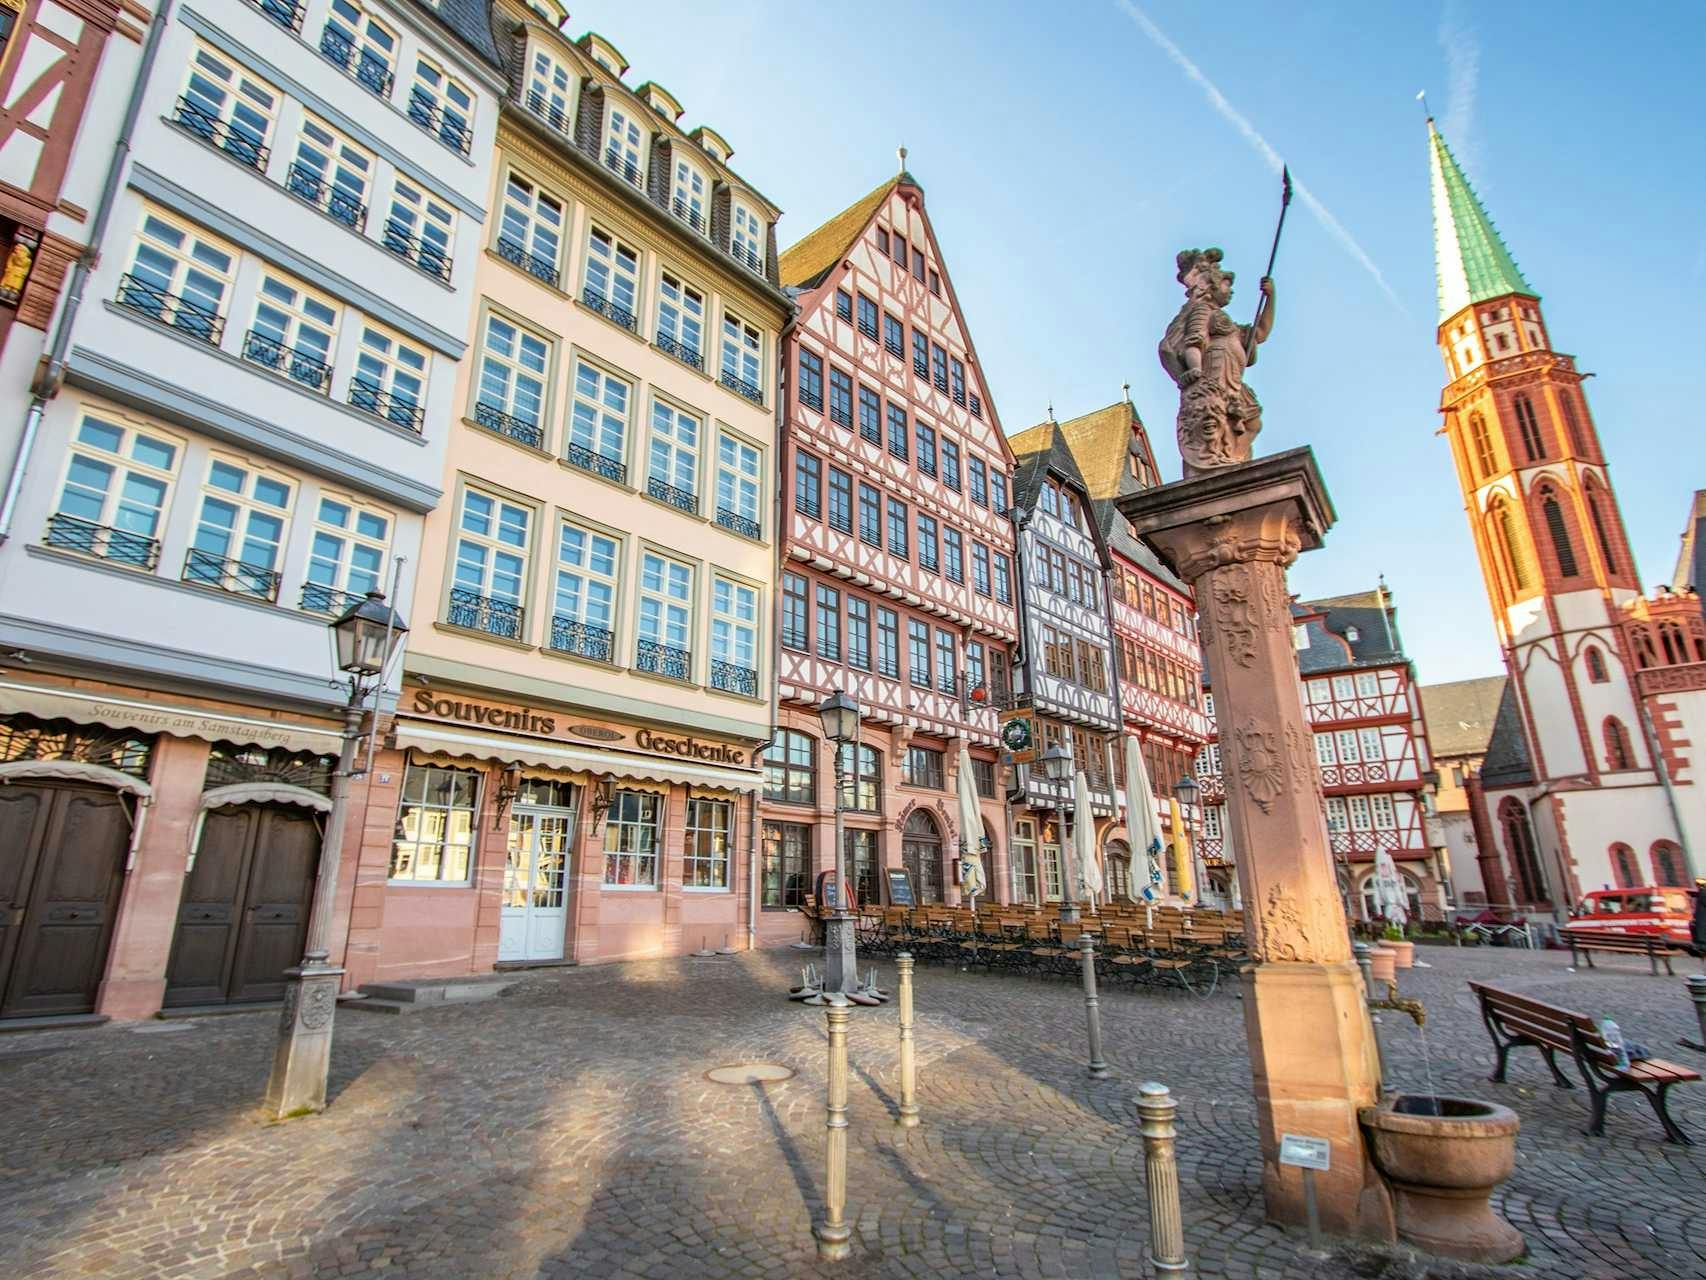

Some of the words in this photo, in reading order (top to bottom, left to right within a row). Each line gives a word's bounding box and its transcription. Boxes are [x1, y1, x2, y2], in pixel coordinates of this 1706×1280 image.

[88, 704, 168, 725] Souvenirs
[172, 718, 195, 728] am
[198, 719, 291, 744] Samstagsberg
[413, 690, 556, 735] Souvenirs
[635, 729, 745, 764] Geschenke
